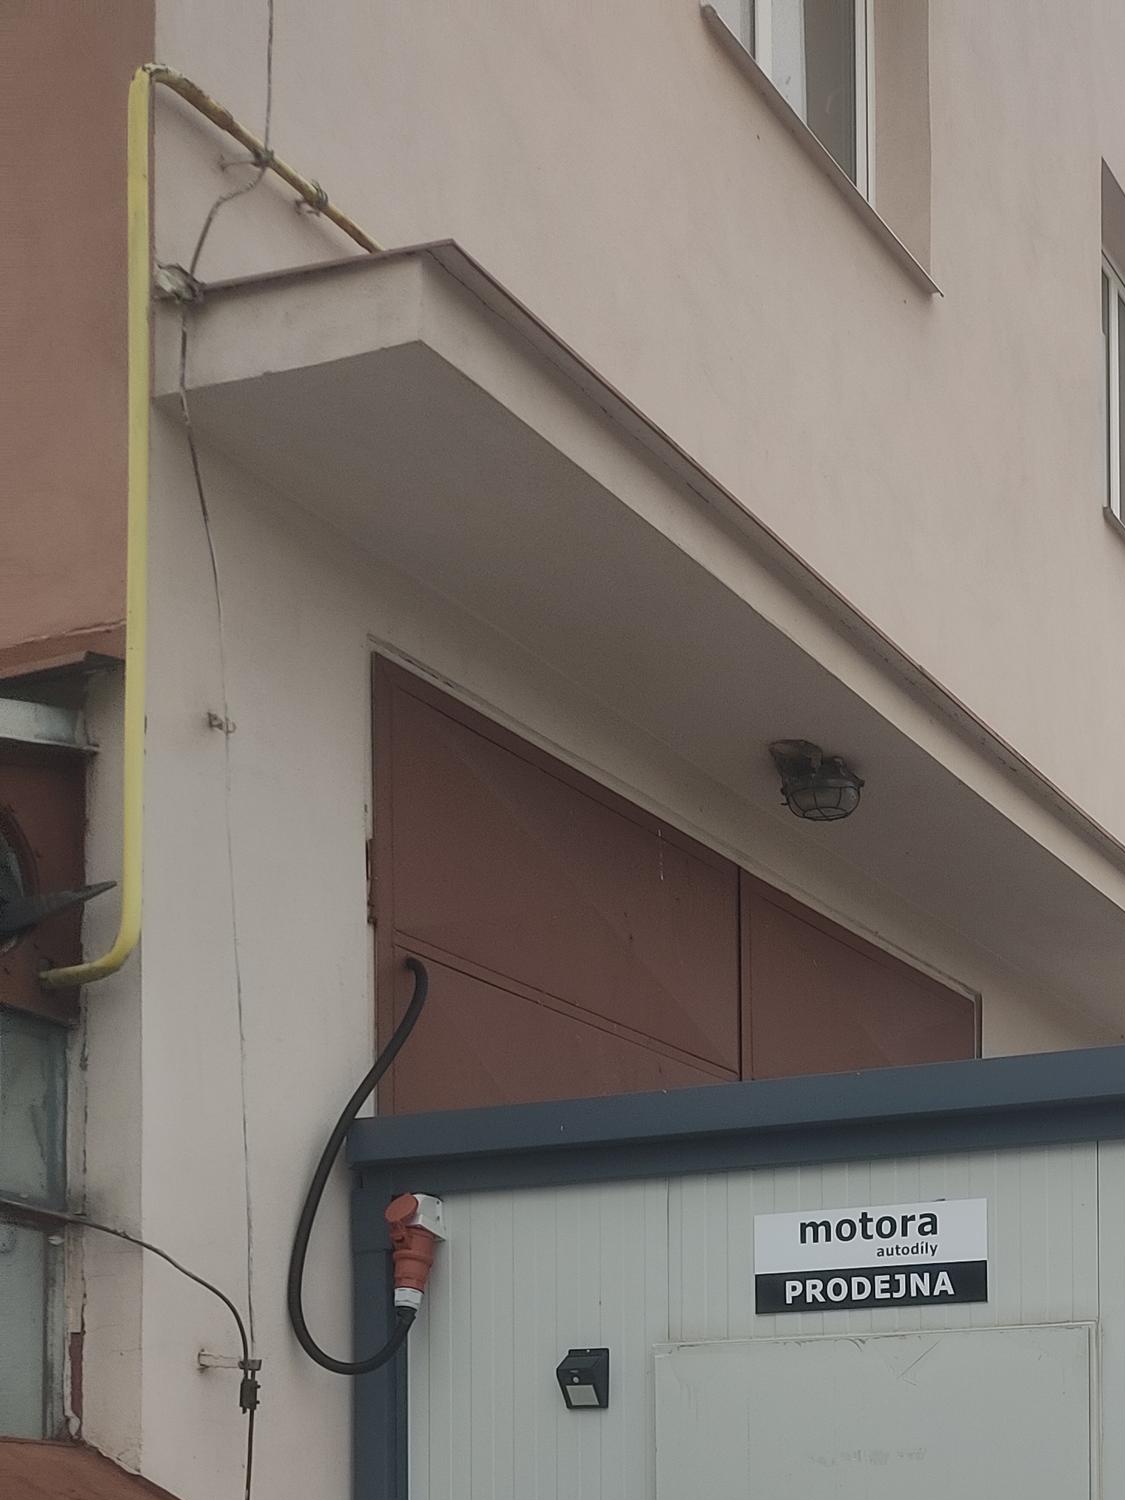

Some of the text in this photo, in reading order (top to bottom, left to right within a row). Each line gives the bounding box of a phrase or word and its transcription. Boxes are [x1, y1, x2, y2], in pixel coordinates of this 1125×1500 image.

[799, 1211, 938, 1244] motora
[876, 1241, 938, 1257] autodíly
[784, 1271, 956, 1305] PRODEJNA
